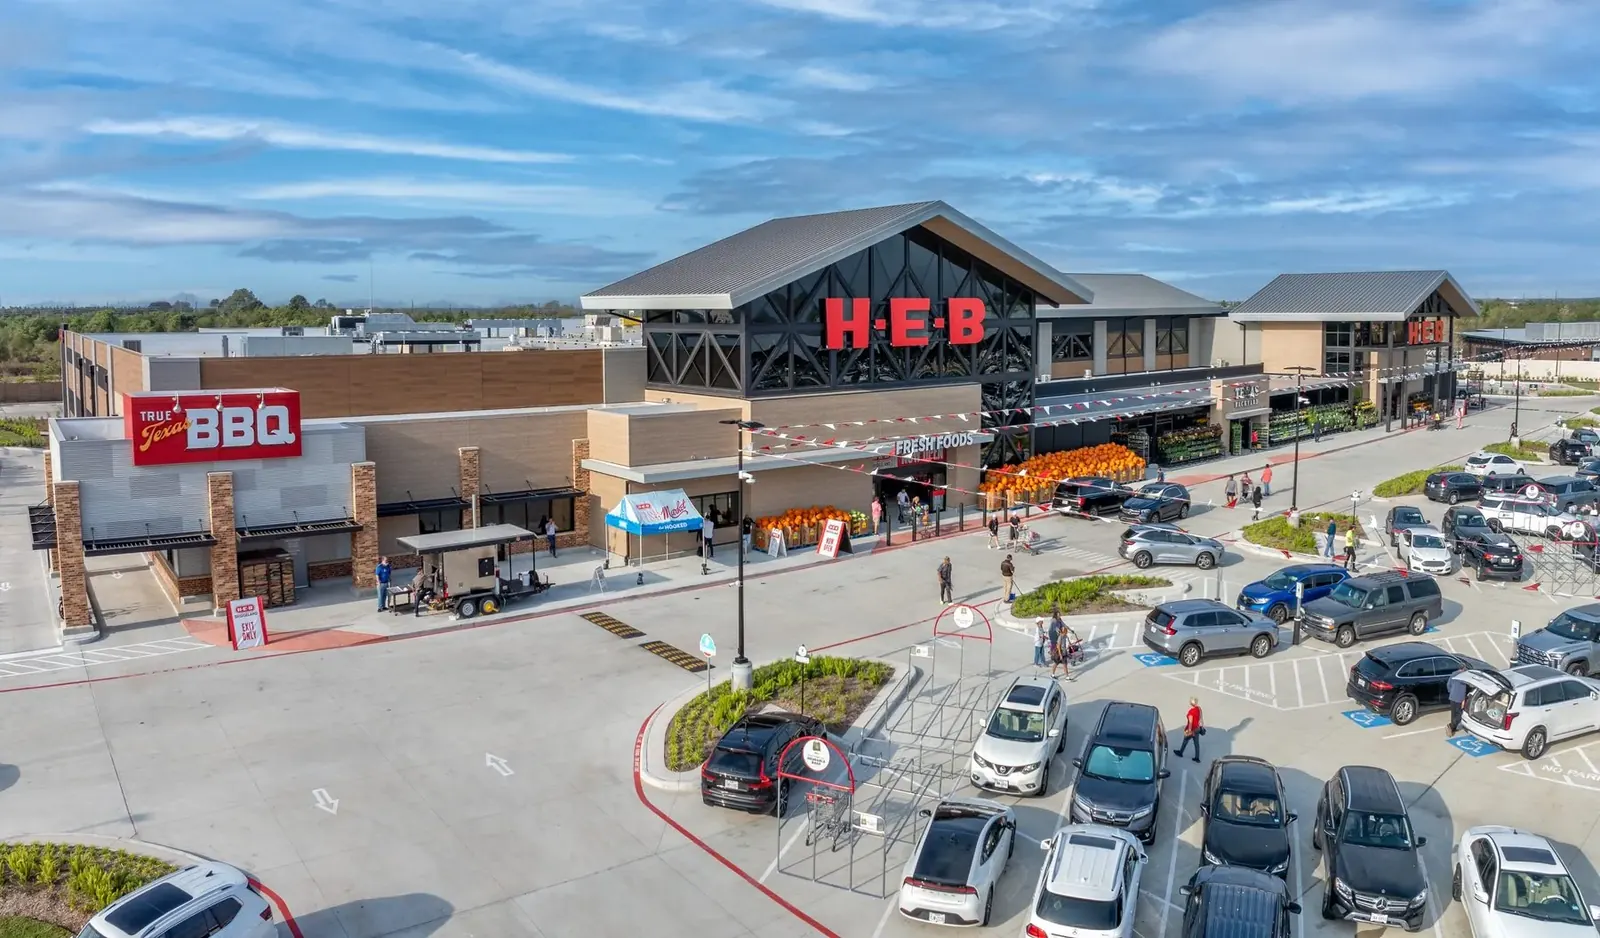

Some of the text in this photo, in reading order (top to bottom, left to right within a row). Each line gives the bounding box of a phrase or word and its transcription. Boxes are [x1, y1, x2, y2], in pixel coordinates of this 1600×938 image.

[825, 297, 986, 349] H-E-B
[140, 411, 172, 422] TRUE
[139, 417, 193, 452] Texas
[185, 405, 296, 452] BBQ
[896, 433, 974, 455] FRESH FOODS
[241, 621, 255, 632] EXIT
[242, 630, 257, 641] ONLY
[1541, 764, 1563, 773] NO
